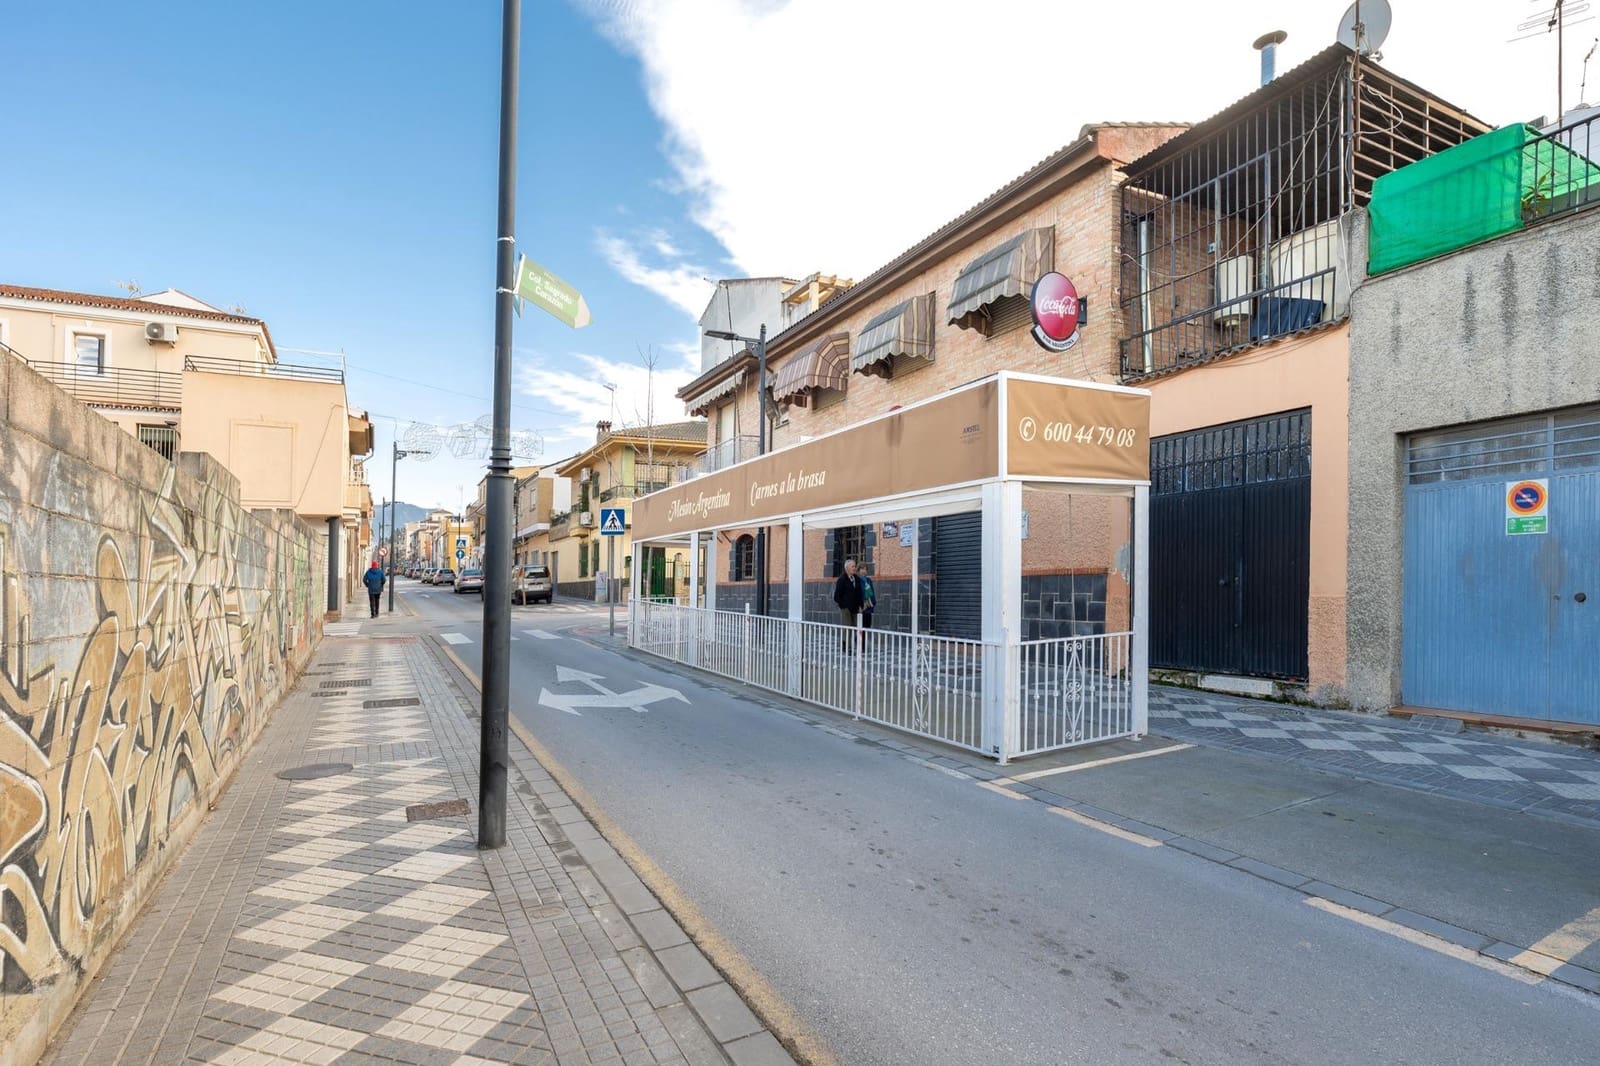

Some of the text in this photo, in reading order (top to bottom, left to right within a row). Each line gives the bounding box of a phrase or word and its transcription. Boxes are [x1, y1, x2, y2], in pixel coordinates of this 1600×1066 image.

[1044, 421, 1136, 448] 600 44 79 08
[692, 488, 731, 519] Argentina
[751, 470, 826, 506] Carnes a la brasa
